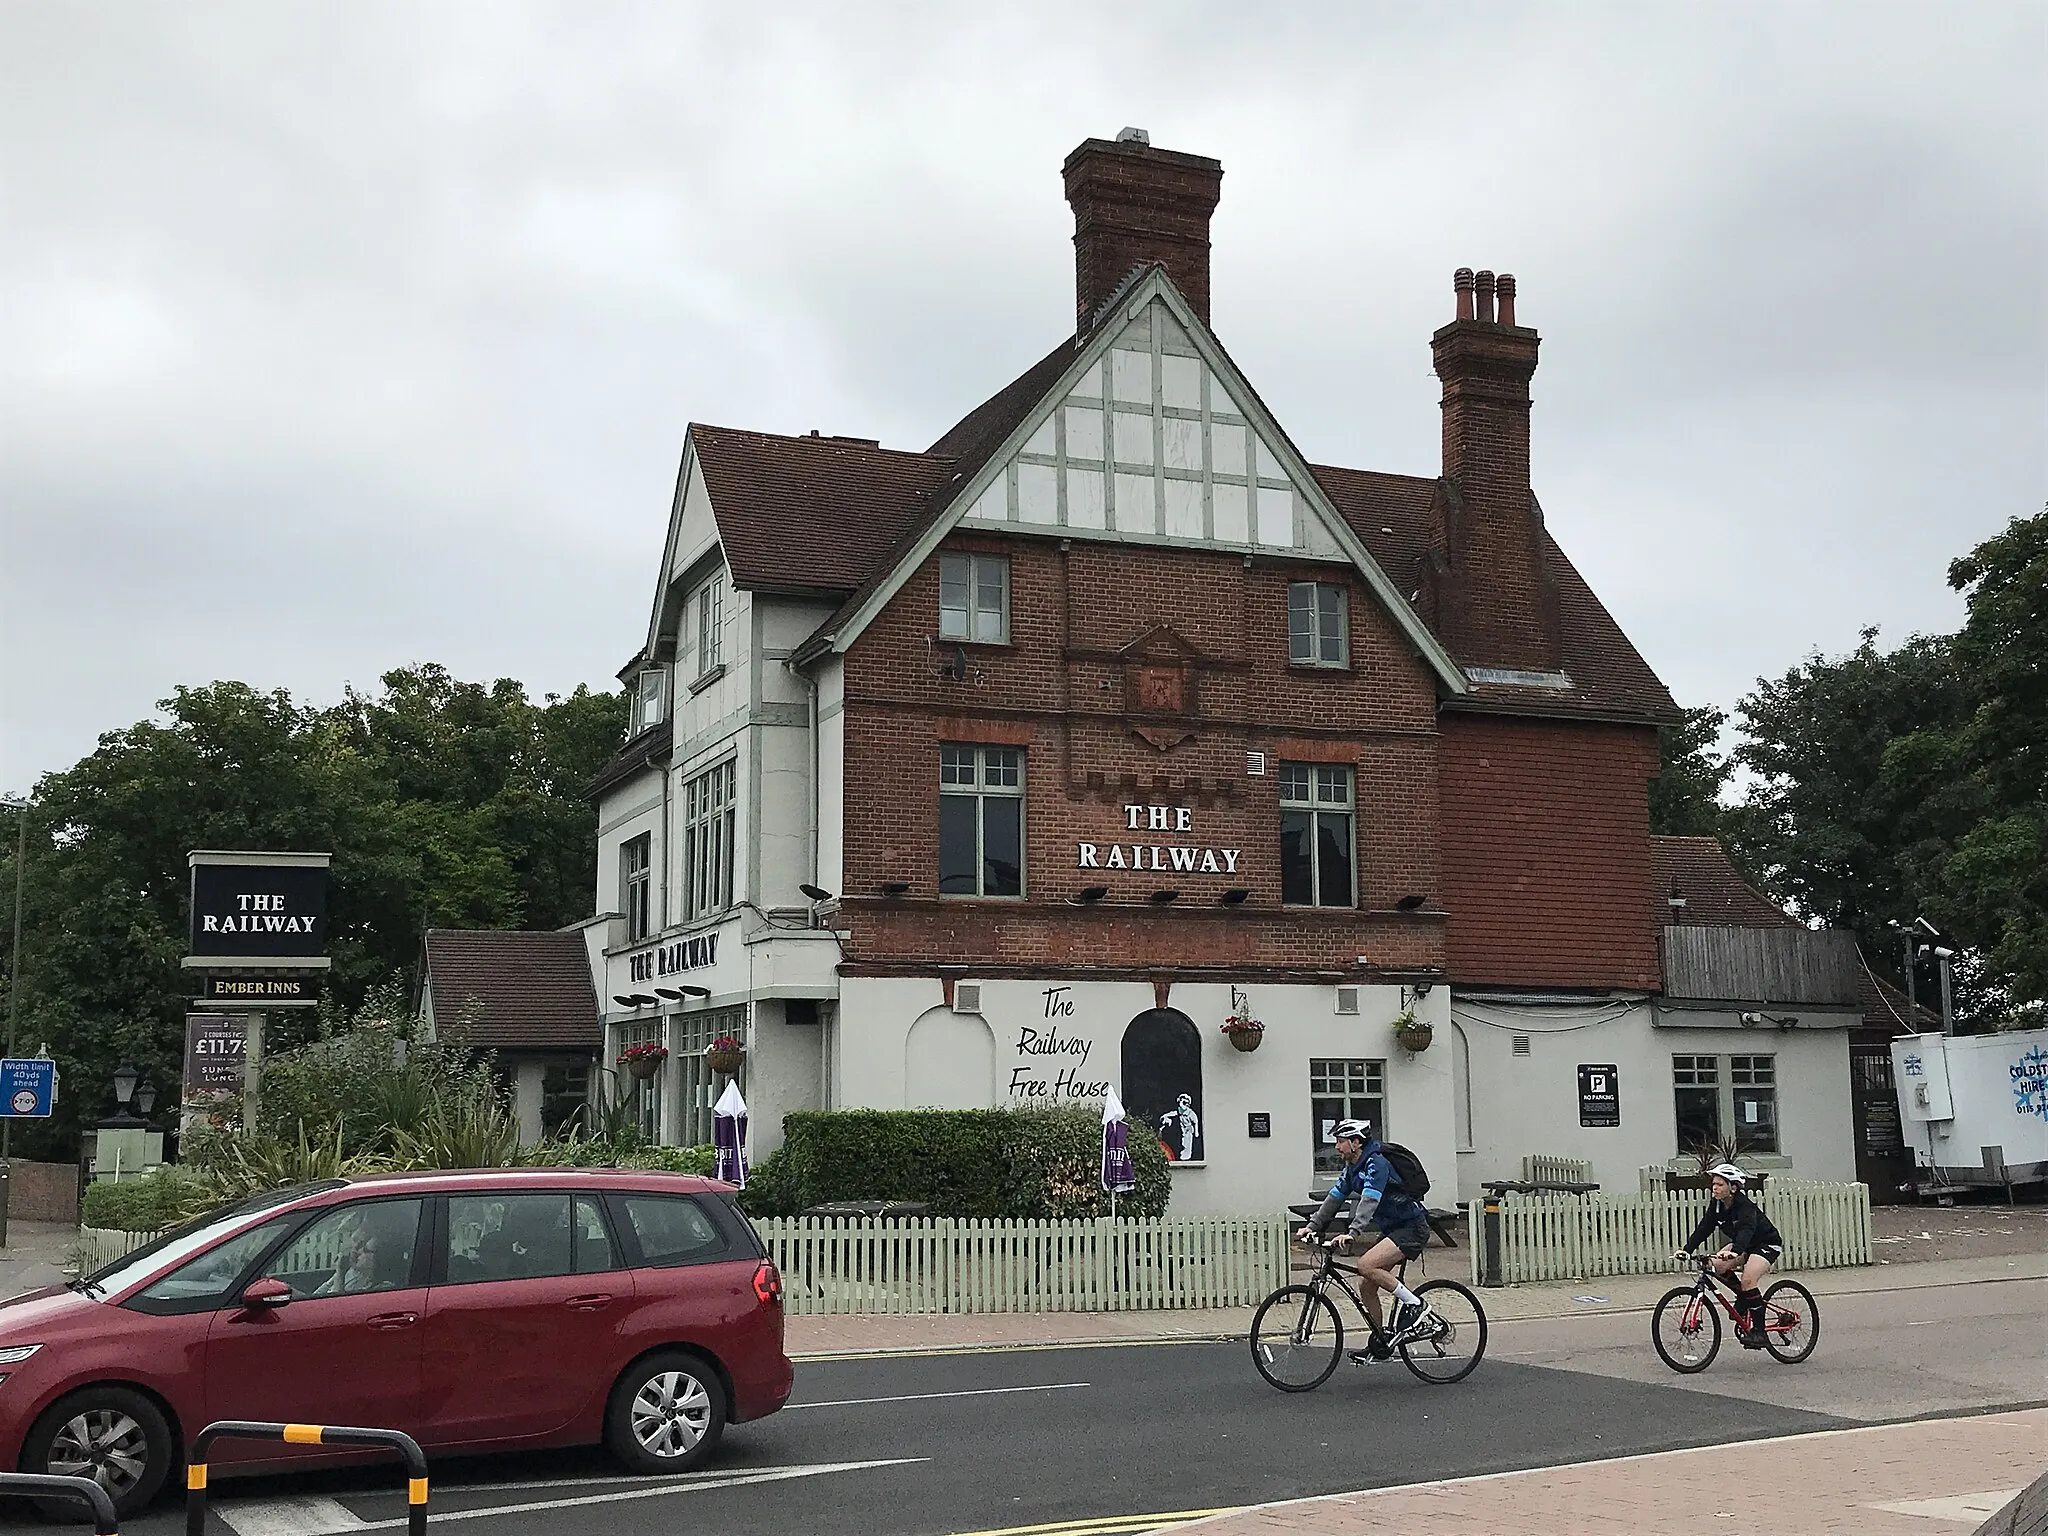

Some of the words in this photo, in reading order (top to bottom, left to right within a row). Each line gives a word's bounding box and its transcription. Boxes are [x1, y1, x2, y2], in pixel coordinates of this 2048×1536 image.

[1124, 804, 1192, 832] THE
[1078, 843, 1241, 873] RAILWAY
[236, 894, 285, 911] THE
[202, 915, 316, 933] RAILWAY
[630, 949, 655, 984] THE
[658, 931, 720, 976] RAILWAY
[214, 981, 265, 994] EMBER
[266, 981, 301, 994] INNS
[1042, 987, 1075, 1018] The
[1016, 1026, 1092, 1067] Railway
[31, 1063, 50, 1071] limit
[1009, 1067, 1048, 1097] Free
[1055, 1068, 1108, 1097] House
[2020, 1080, 2046, 1094] HIRE
[2016, 1105, 2034, 1114] 0115
